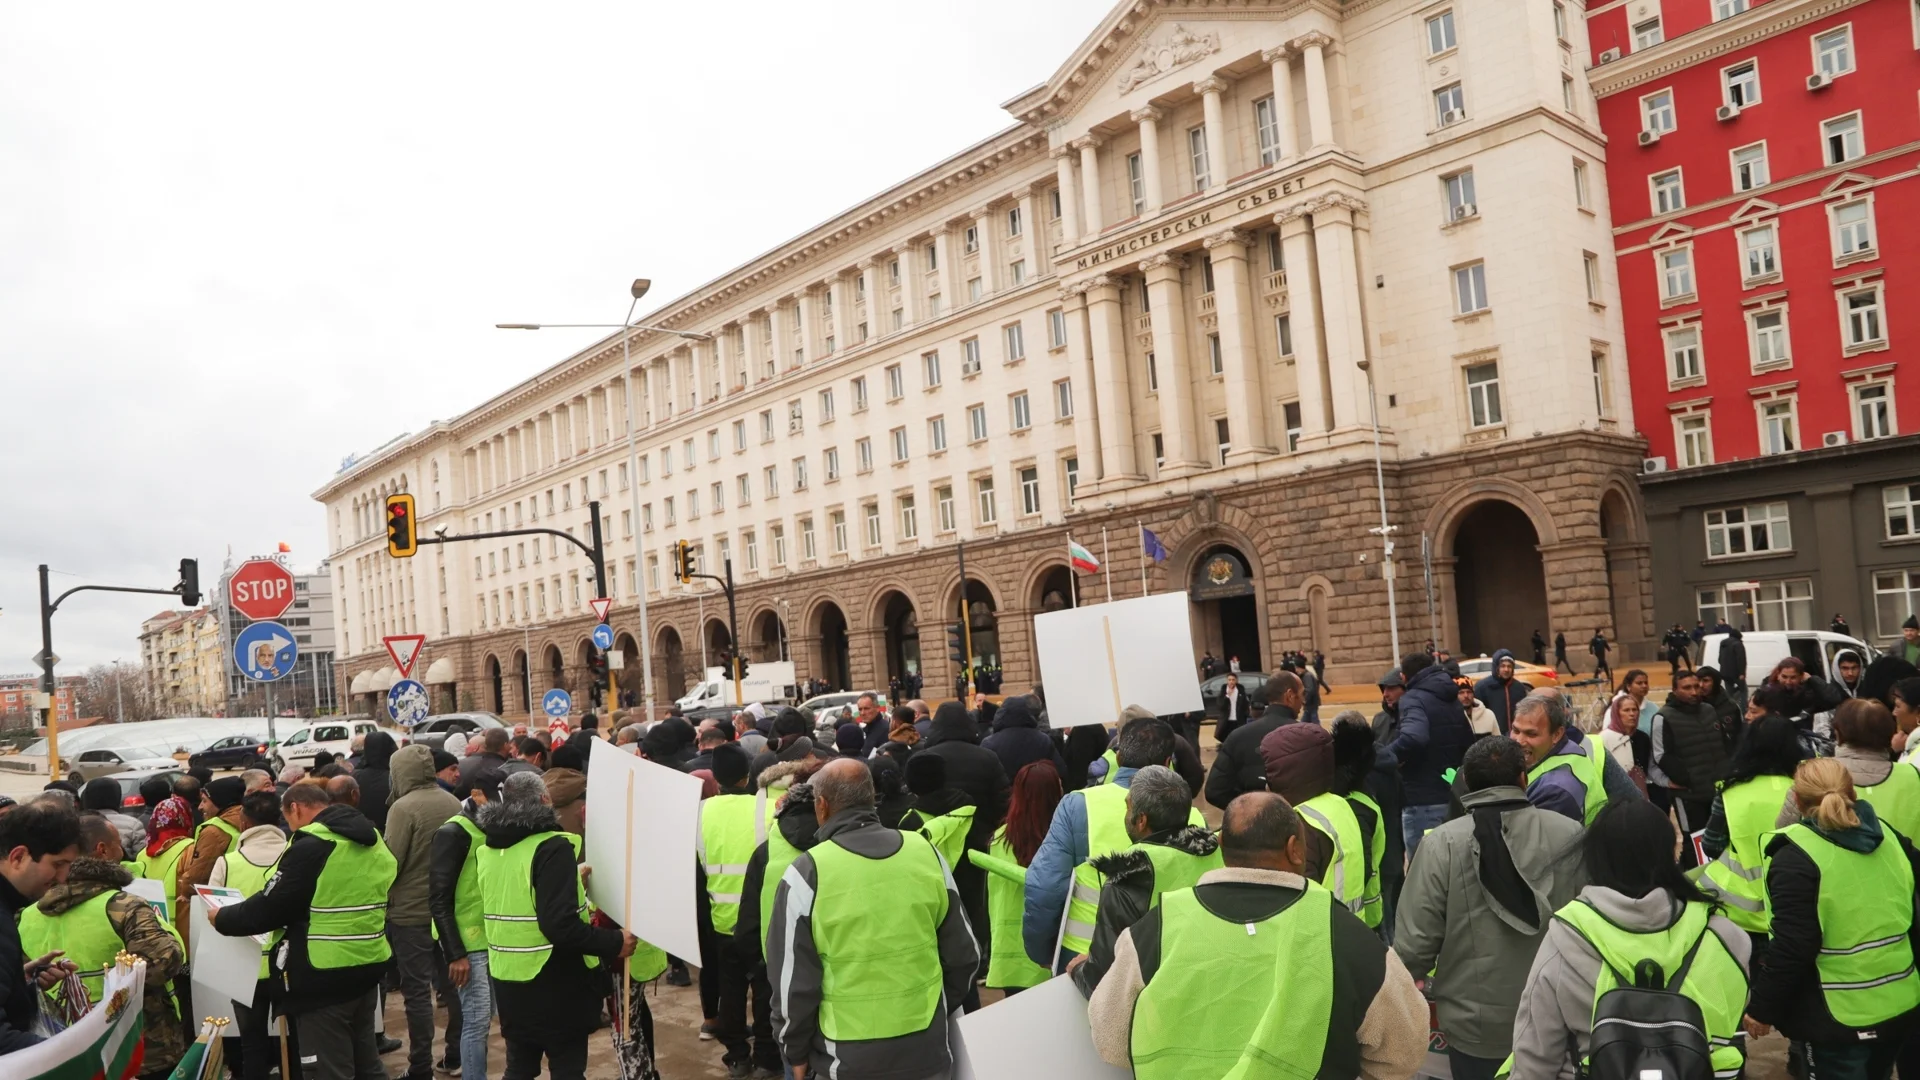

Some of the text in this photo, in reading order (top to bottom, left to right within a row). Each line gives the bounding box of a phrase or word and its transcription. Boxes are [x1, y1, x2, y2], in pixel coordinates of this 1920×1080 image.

[1077, 177, 1306, 270] МИНИСТЕРСКИ СЪВЕТ
[236, 578, 288, 602] STOP
